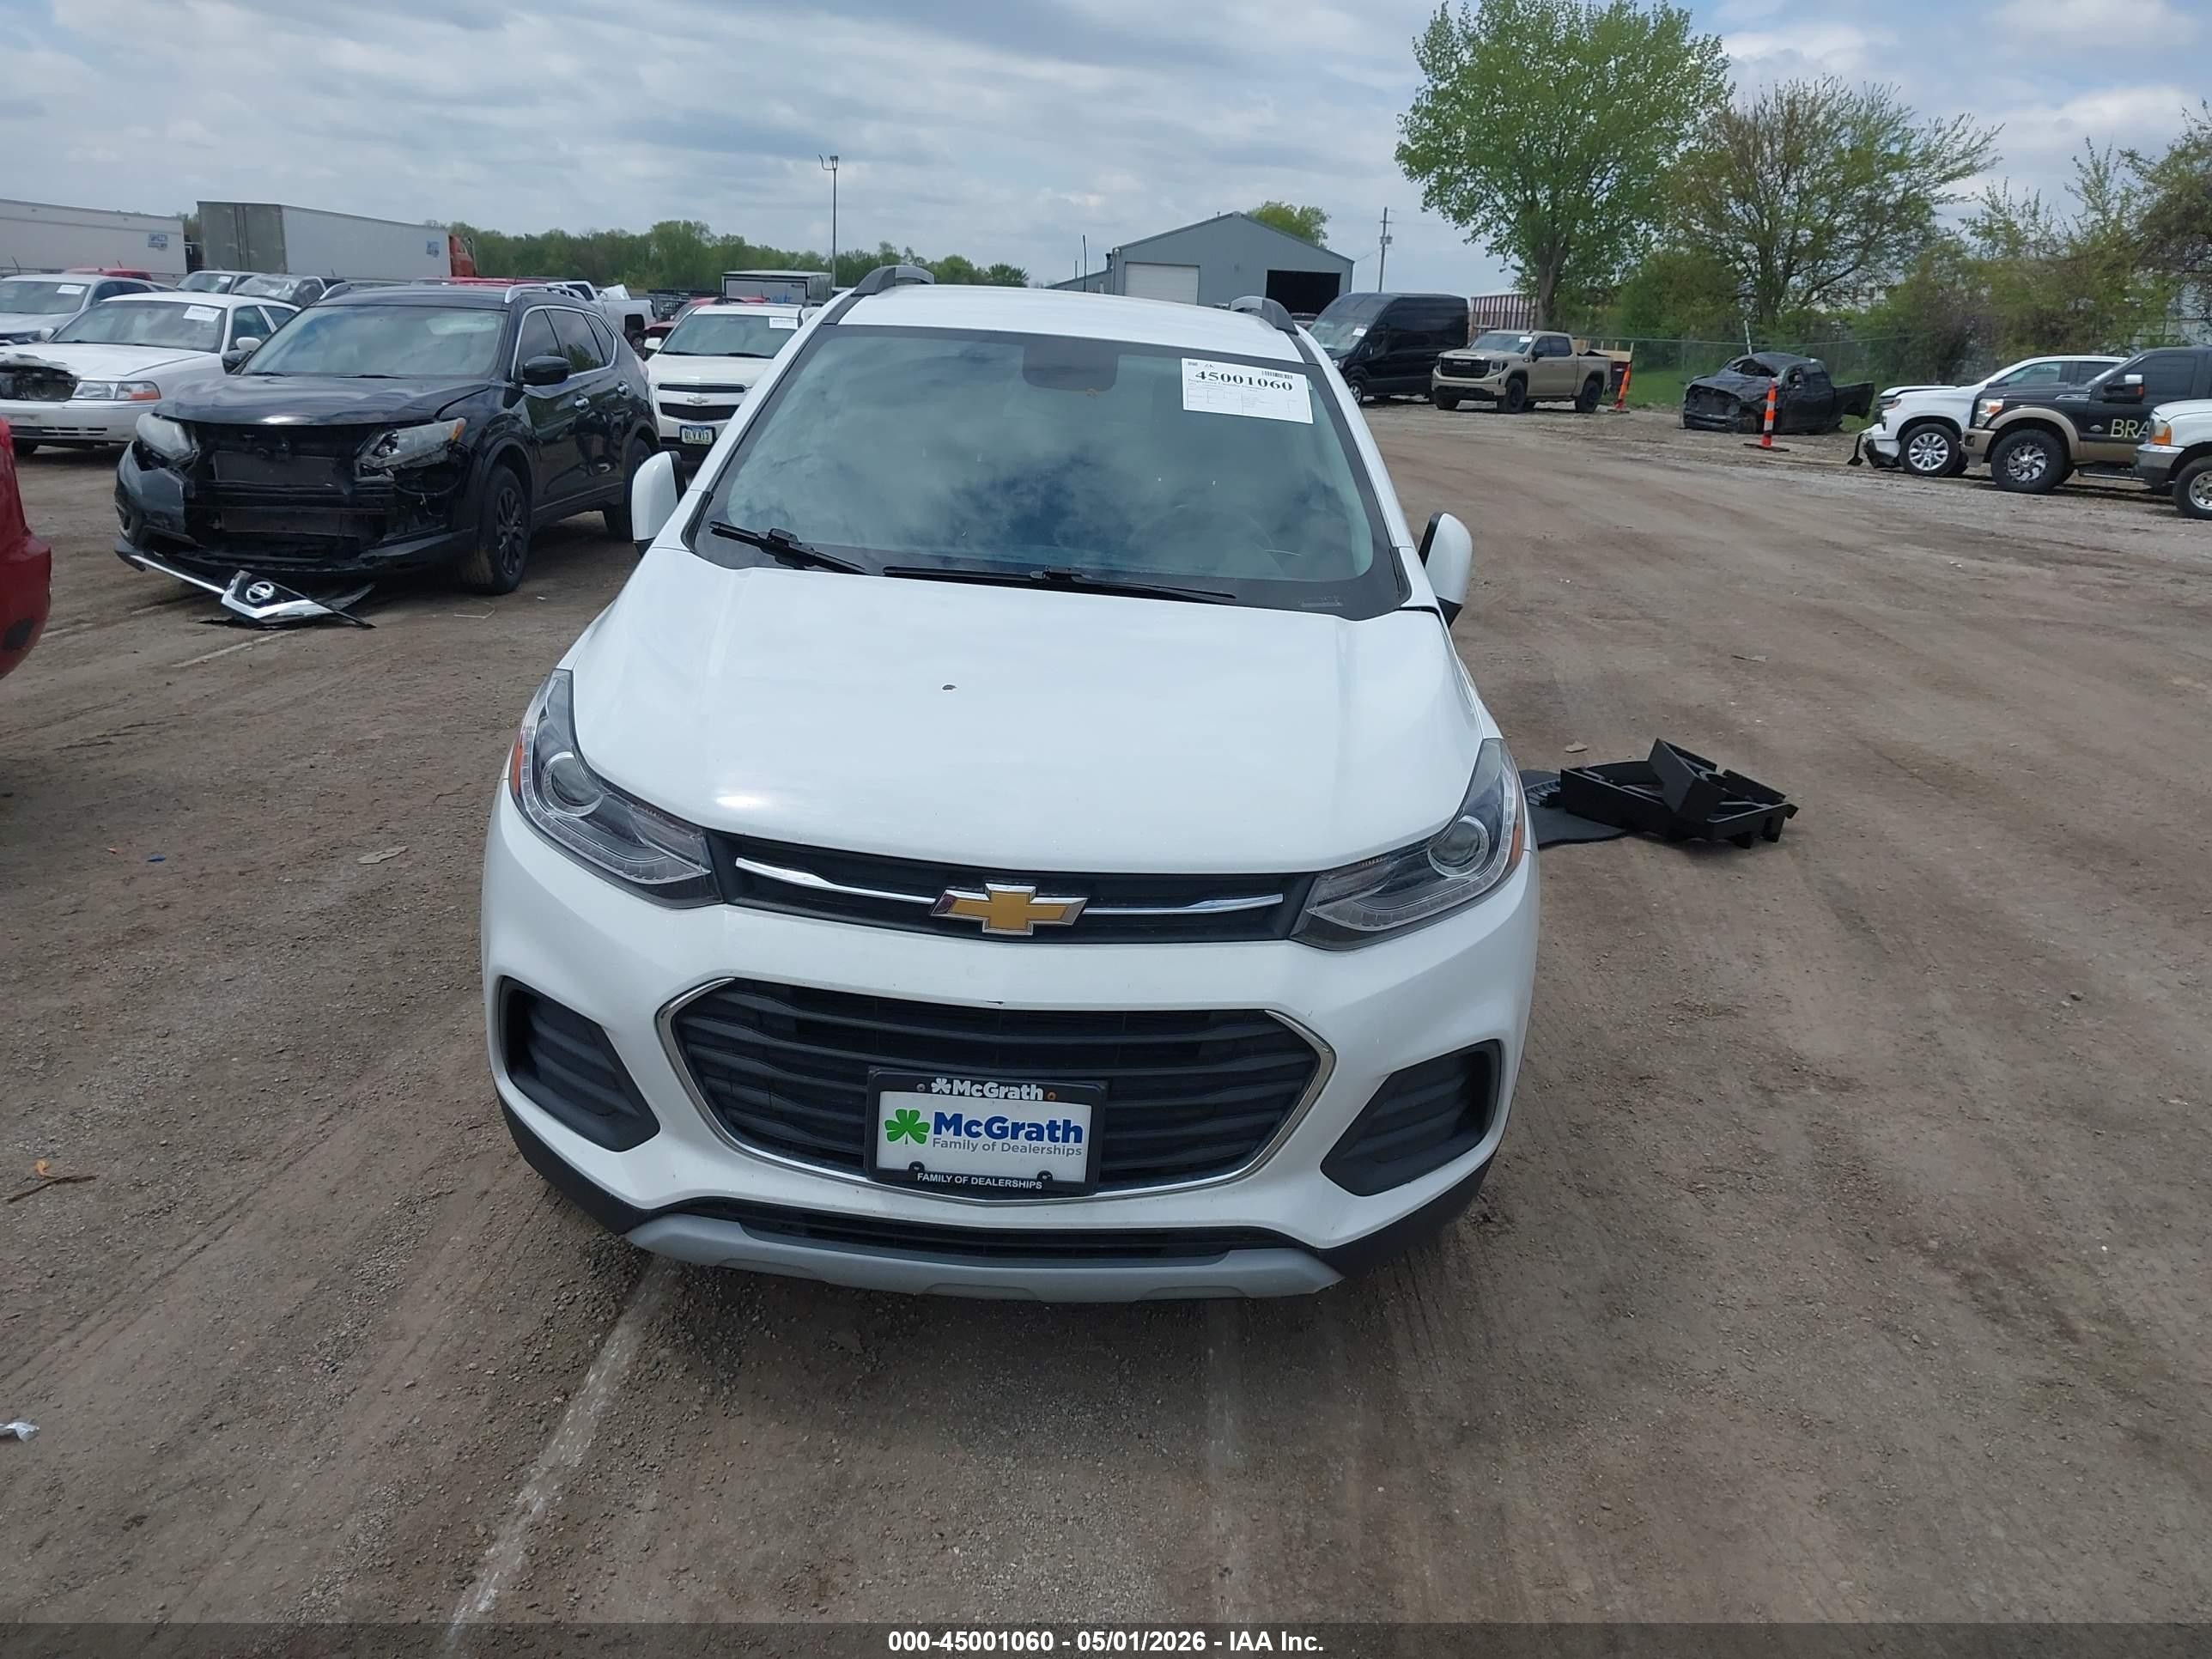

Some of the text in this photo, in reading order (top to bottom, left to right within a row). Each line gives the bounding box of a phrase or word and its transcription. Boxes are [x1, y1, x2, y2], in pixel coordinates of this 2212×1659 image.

[1195, 370, 1293, 392] 45001060
[952, 1079, 1044, 1101] McGrath
[933, 1111, 1083, 1144] McGrath
[933, 1137, 1082, 1158] Family of Dealerships
[917, 1173, 1042, 1189] FAMILY OF DEALERSHIPS
